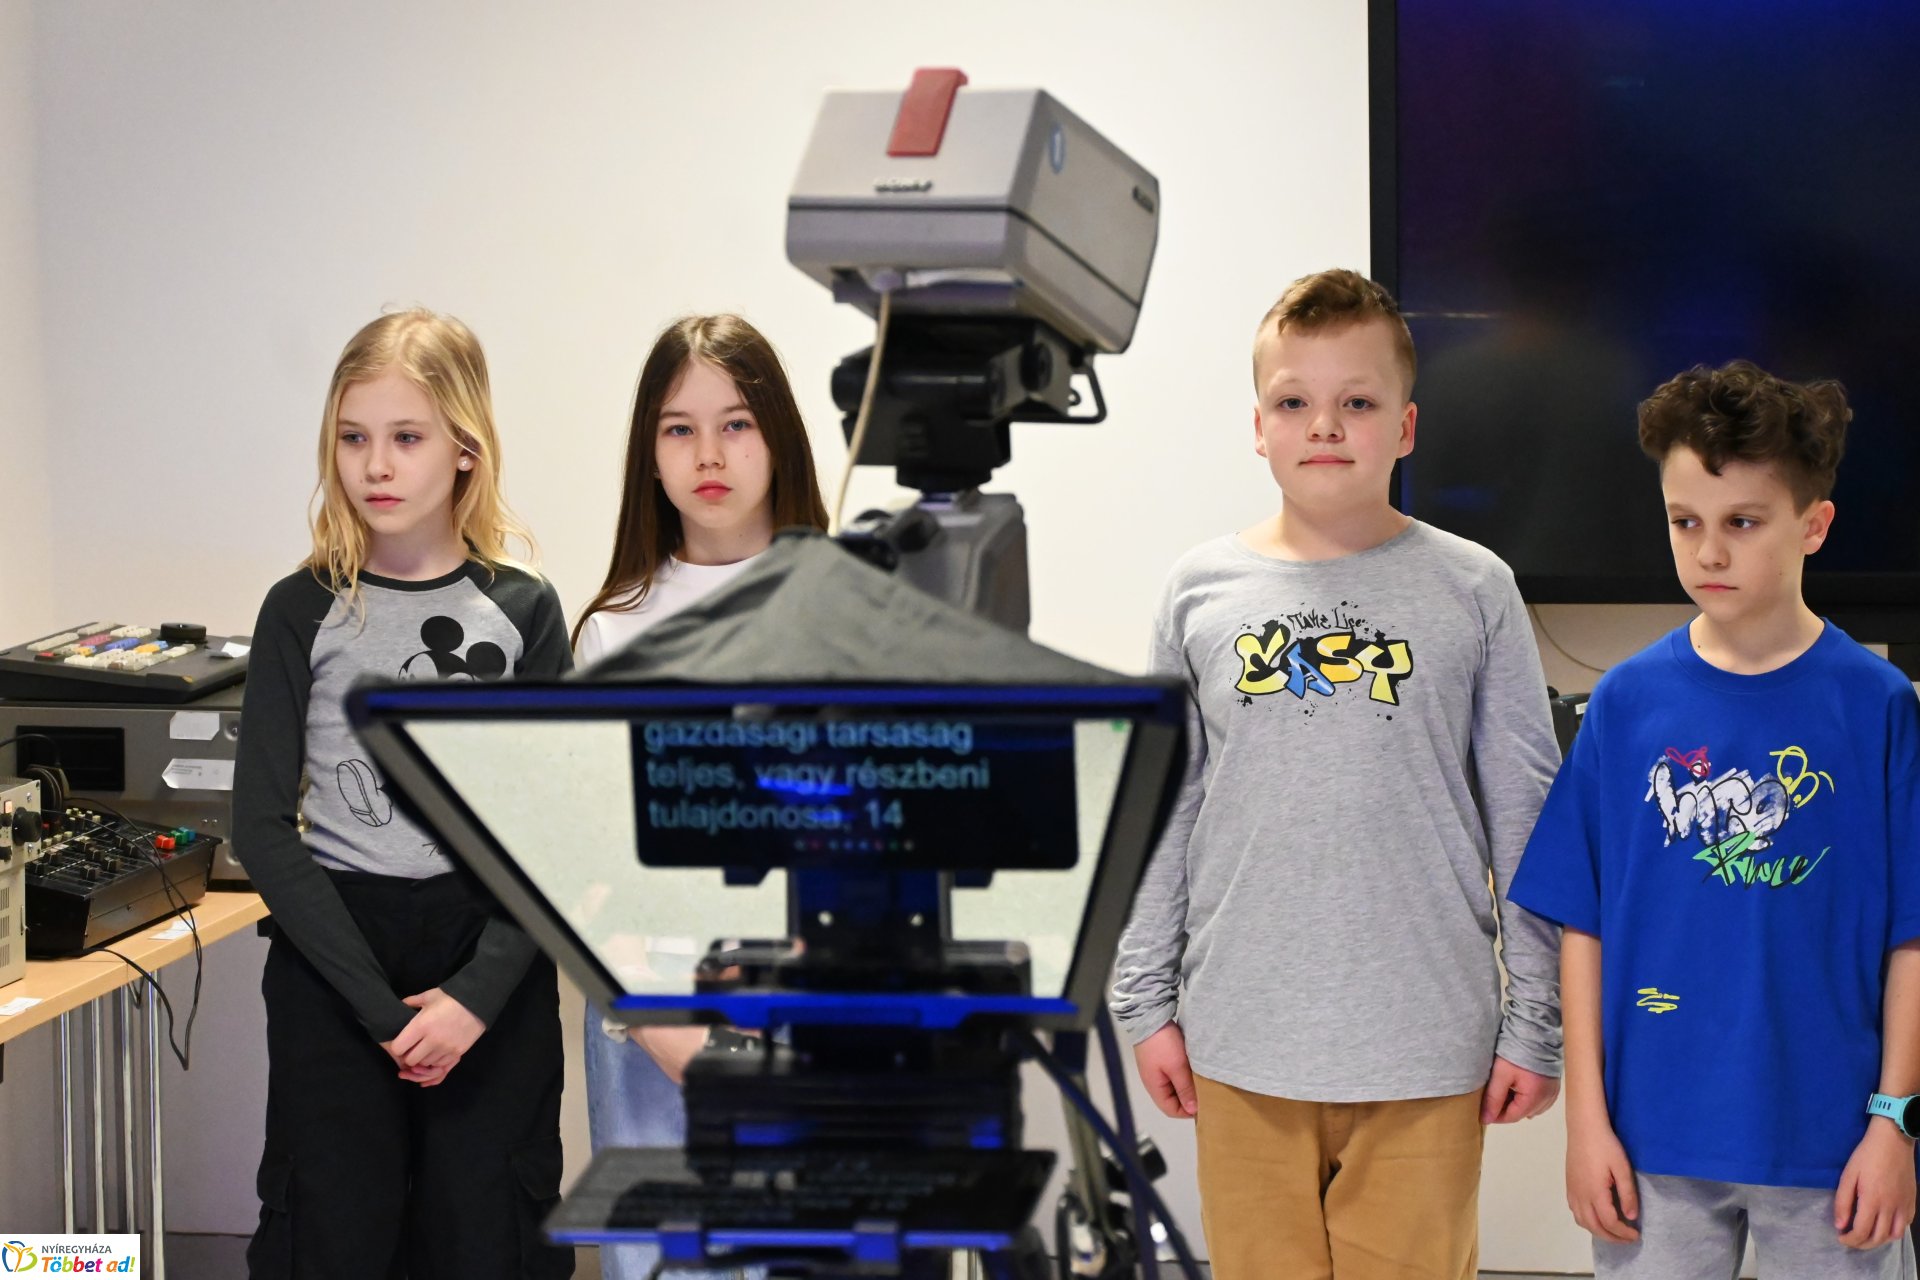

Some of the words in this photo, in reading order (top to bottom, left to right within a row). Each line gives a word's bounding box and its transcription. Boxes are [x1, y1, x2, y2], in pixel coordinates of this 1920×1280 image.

[1286, 607, 1332, 631] Take
[1234, 622, 1413, 706] EASY
[754, 763, 836, 795] vagy
[846, 757, 990, 788] részbeni
[865, 800, 903, 829] 14
